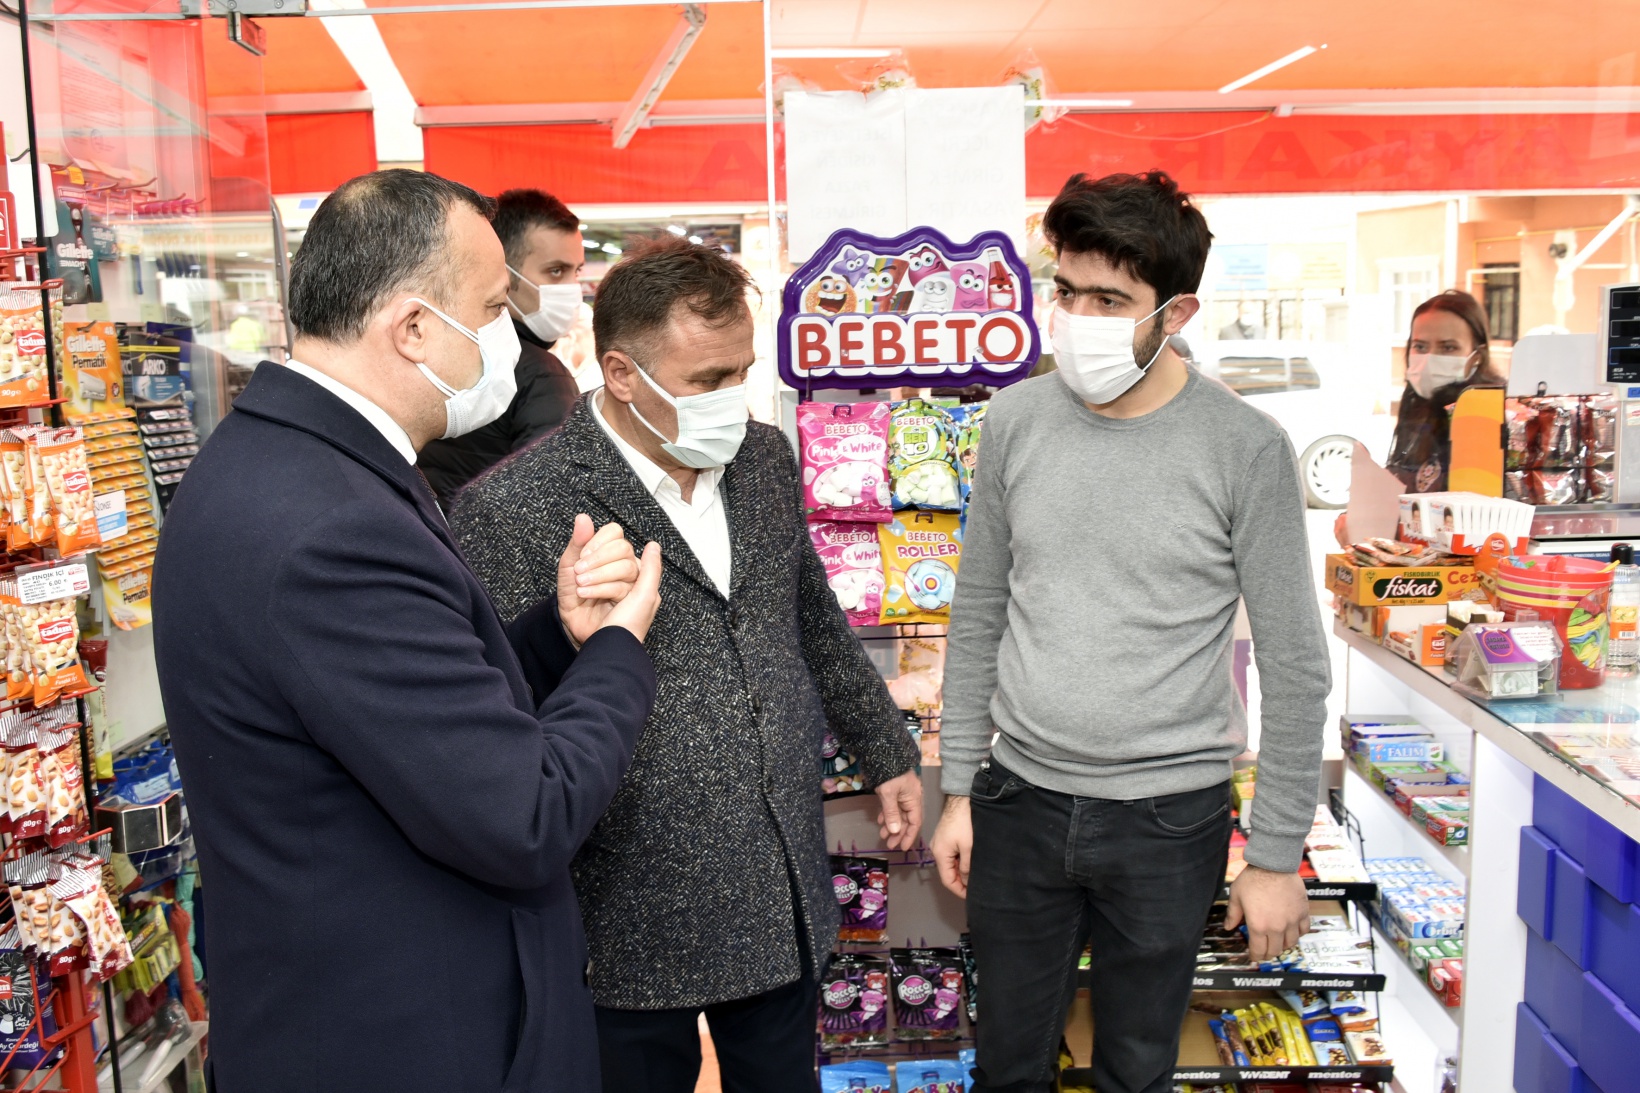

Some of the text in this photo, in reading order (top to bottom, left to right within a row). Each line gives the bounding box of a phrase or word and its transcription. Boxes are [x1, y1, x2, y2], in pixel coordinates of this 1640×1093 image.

[56, 243, 94, 259] Gillette
[66, 335, 107, 353] Gillette
[797, 316, 1025, 371] BEBETO
[72, 353, 107, 369] Permatik
[142, 358, 167, 375] ARKO
[896, 416, 934, 427] BEBETO
[826, 424, 867, 435] BEBETO
[903, 432, 928, 444] BEN
[812, 444, 838, 458] Pink
[850, 442, 882, 453] White
[903, 443, 929, 456] 10
[830, 532, 871, 543] BEBETO
[907, 532, 947, 542] BEBETO
[854, 550, 881, 561] Whit
[897, 543, 959, 558] ROLLER
[1376, 575, 1438, 602] fiskat
[1388, 747, 1424, 758] FALIM
[834, 882, 856, 893] OCCO
[1307, 887, 1346, 897] entos
[1301, 978, 1355, 988] mentos
[1308, 1070, 1361, 1079] mentos
